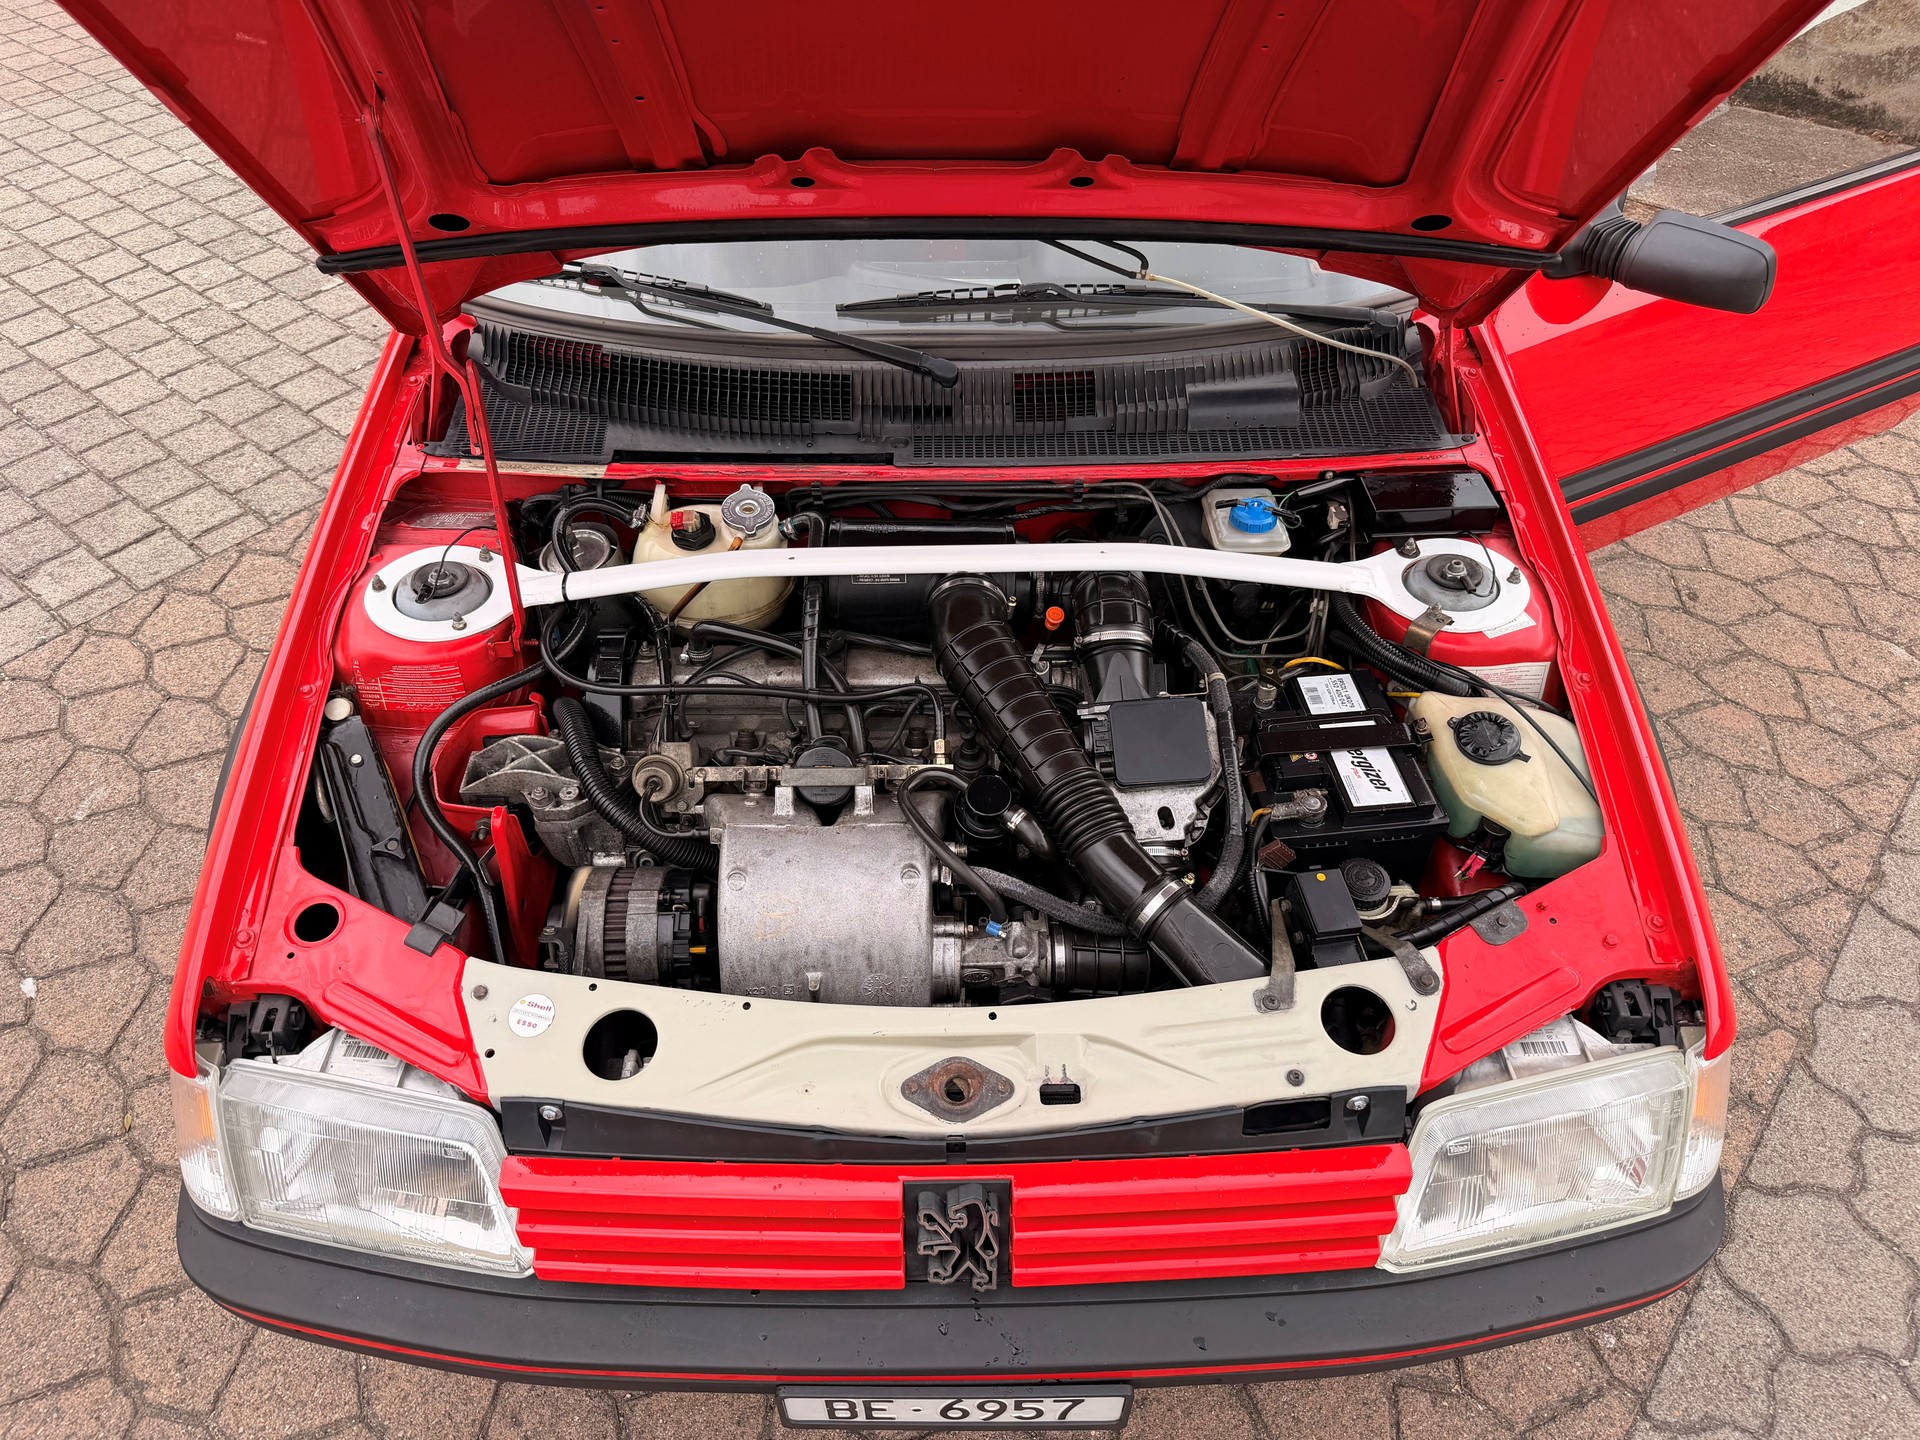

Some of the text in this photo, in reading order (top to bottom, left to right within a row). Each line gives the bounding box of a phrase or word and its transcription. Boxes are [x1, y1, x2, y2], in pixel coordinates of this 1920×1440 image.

[1347, 748, 1393, 792] ergizer
[527, 1001, 552, 1012] Shell
[516, 1018, 538, 1029] ESSO
[824, 1398, 1086, 1421] BE 6957
